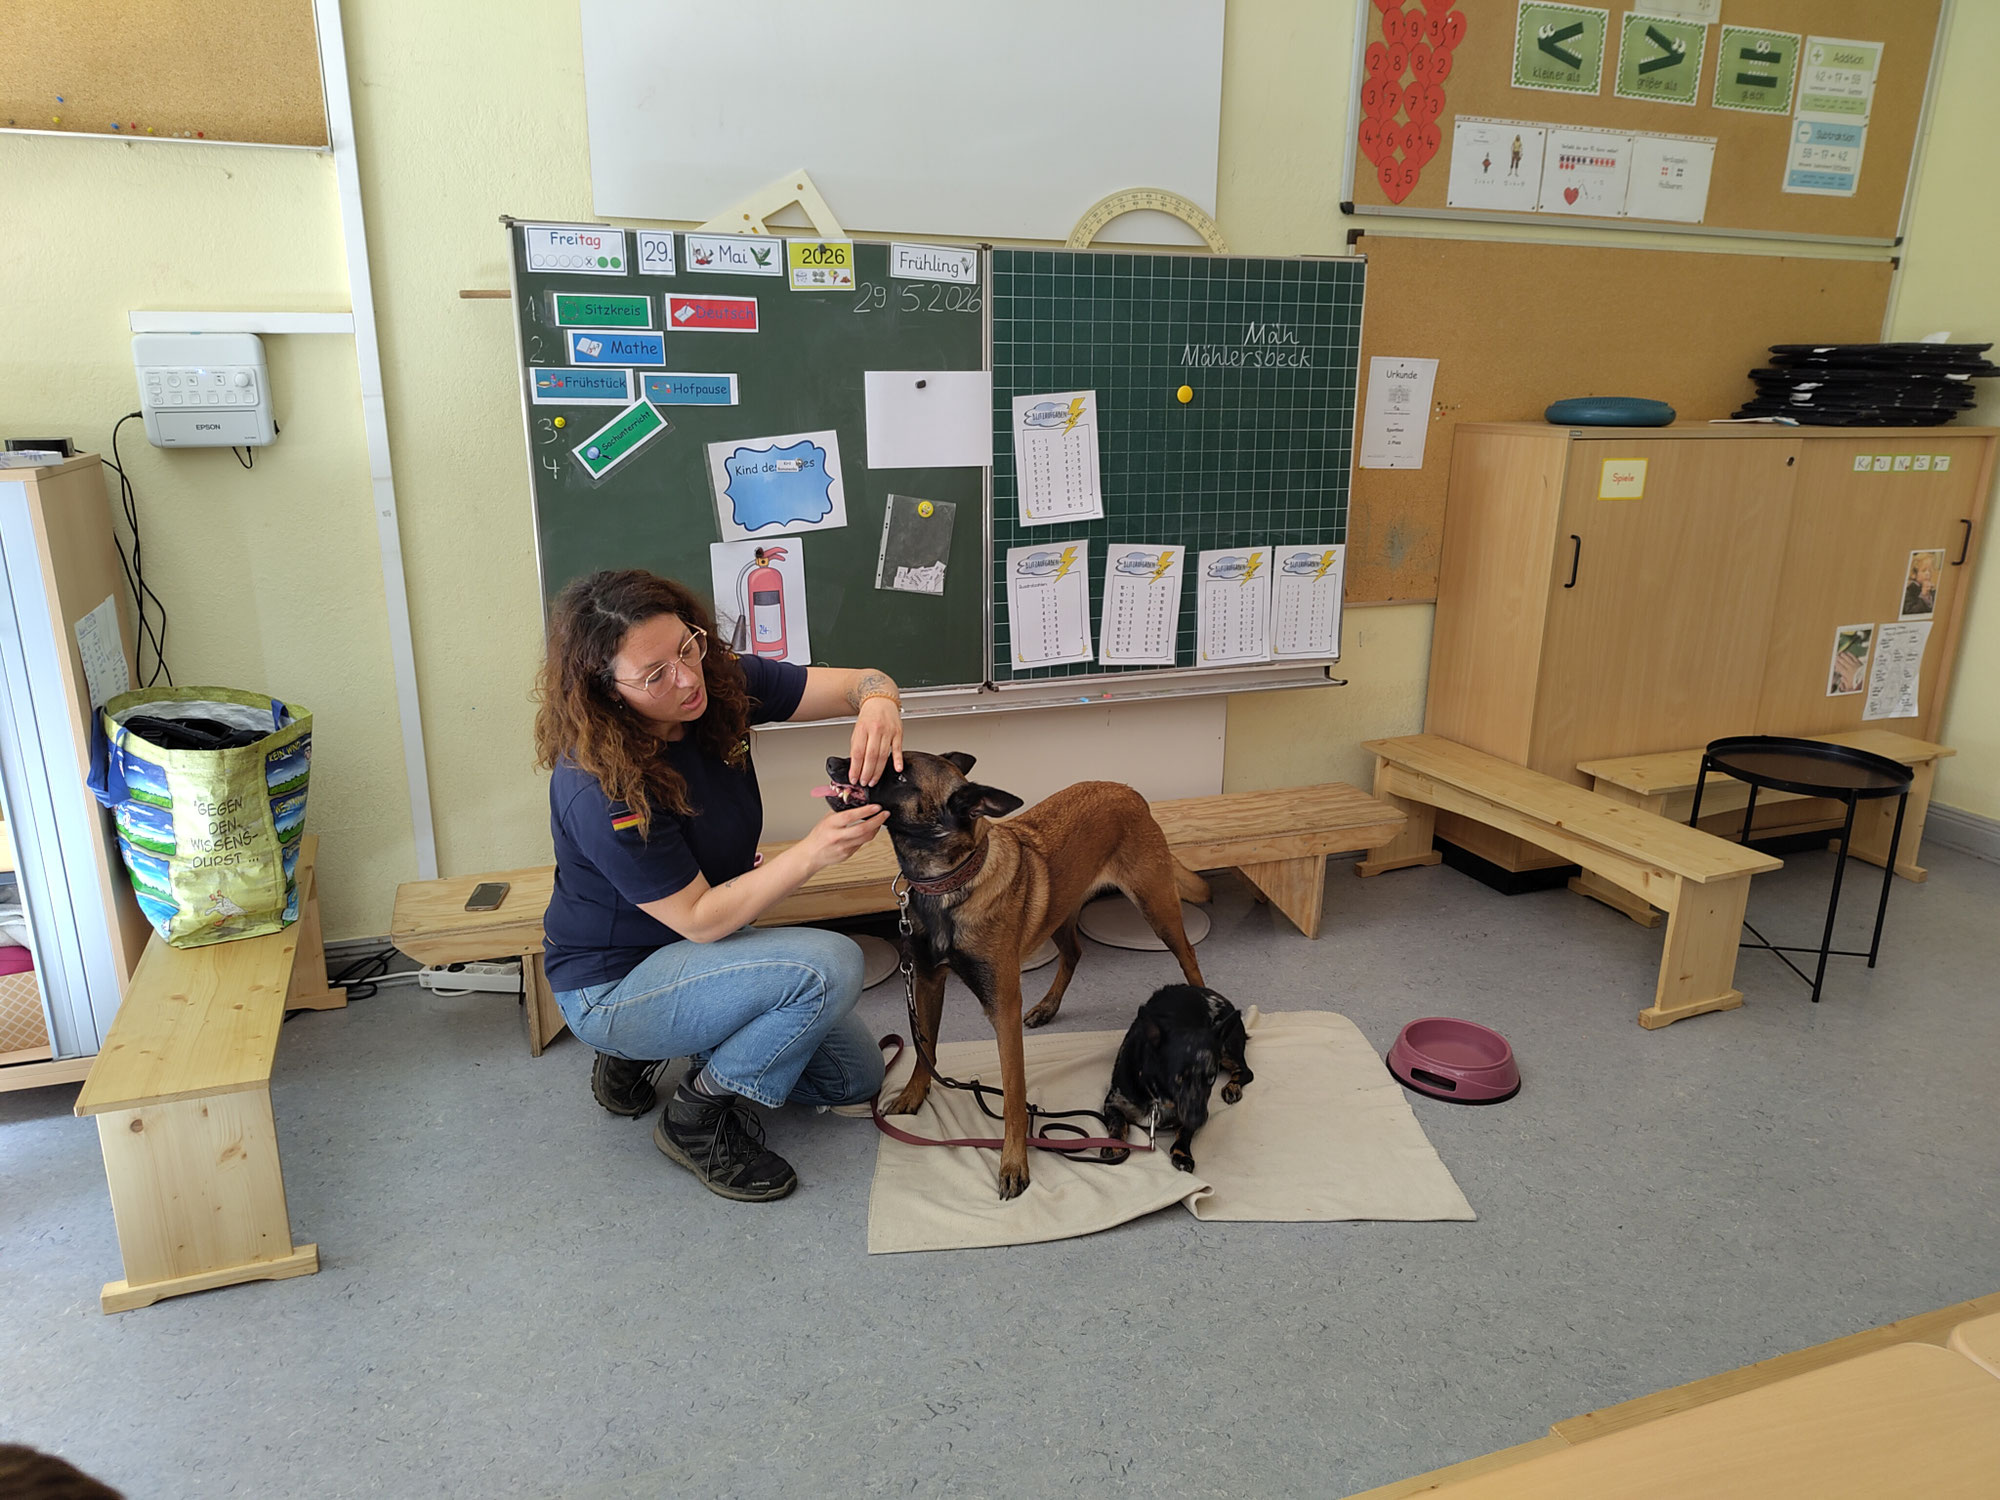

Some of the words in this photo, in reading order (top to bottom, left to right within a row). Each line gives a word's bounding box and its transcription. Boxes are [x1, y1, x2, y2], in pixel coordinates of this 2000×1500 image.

[1391, 21, 1396, 36] 1
[1411, 22, 1418, 37] 9
[1431, 21, 1438, 36] 9
[1452, 24, 1457, 39] 1
[1372, 54, 1380, 70] 2
[1393, 56, 1401, 71] 8
[1416, 56, 1424, 70] 8
[1437, 58, 1445, 73] 2
[1532, 67, 1565, 81] kleiner
[1566, 70, 1580, 82] als
[1637, 77, 1663, 90] größer
[1664, 79, 1677, 91] als
[1368, 90, 1375, 105] 3
[1389, 93, 1397, 108] 7
[1410, 96, 1417, 111] 7
[1431, 99, 1438, 113] 3
[1365, 130, 1372, 144] 4
[1386, 133, 1393, 147] 6
[1406, 134, 1413, 148] 6
[1427, 135, 1434, 149] 4
[1384, 168, 1392, 183] 5
[1405, 169, 1413, 184] 5
[550, 232, 601, 250] Freitag
[644, 241, 672, 262] 29.
[719, 244, 748, 264] Mai
[802, 248, 845, 265] 2026
[900, 251, 959, 278] Frühling
[853, 282, 887, 313] 29
[901, 283, 982, 313] 5.2026
[524, 295, 543, 324] 1.
[584, 303, 641, 317] Sitzkreis
[695, 305, 754, 319] Deutsch
[1244, 321, 1300, 346] Mäh
[529, 335, 556, 364] 2.
[610, 340, 658, 355] Mathe
[1181, 343, 1310, 368] Mählersbeck
[565, 376, 626, 389] Frühstück
[1386, 370, 1418, 380] Urkunde
[673, 383, 727, 396] Hofpause
[601, 411, 650, 451] Sachunterricht
[543, 455, 561, 480] 4
[735, 464, 758, 476] Kind
[1613, 472, 1635, 485] Spiele
[268, 749, 285, 762] KEIN
[209, 817, 237, 835] DEN
[190, 831, 258, 853] WISSENS-
[192, 852, 242, 868] DURST
